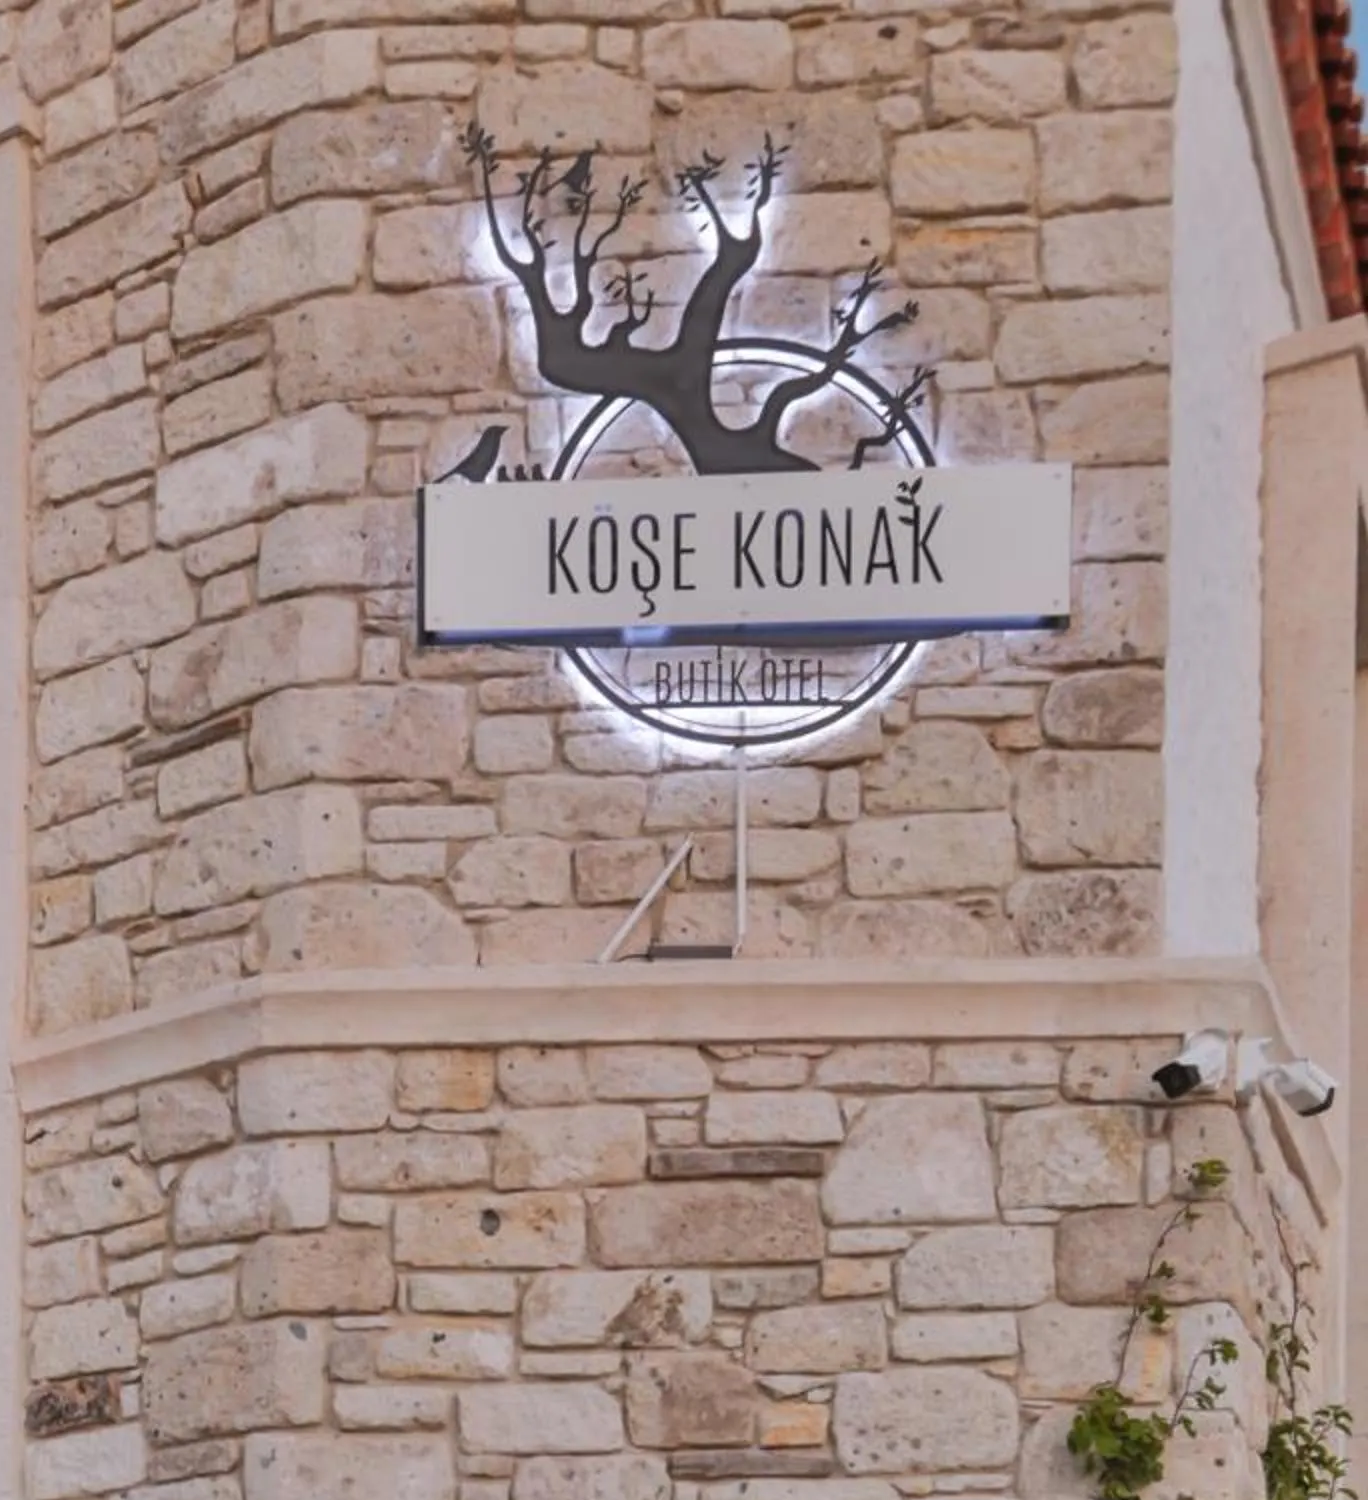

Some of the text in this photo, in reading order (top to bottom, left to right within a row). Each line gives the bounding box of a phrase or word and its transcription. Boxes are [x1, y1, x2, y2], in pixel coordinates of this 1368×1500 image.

[548, 503, 944, 618] KÖŞE KONAK
[656, 650, 829, 704] BUTİK OTEL
